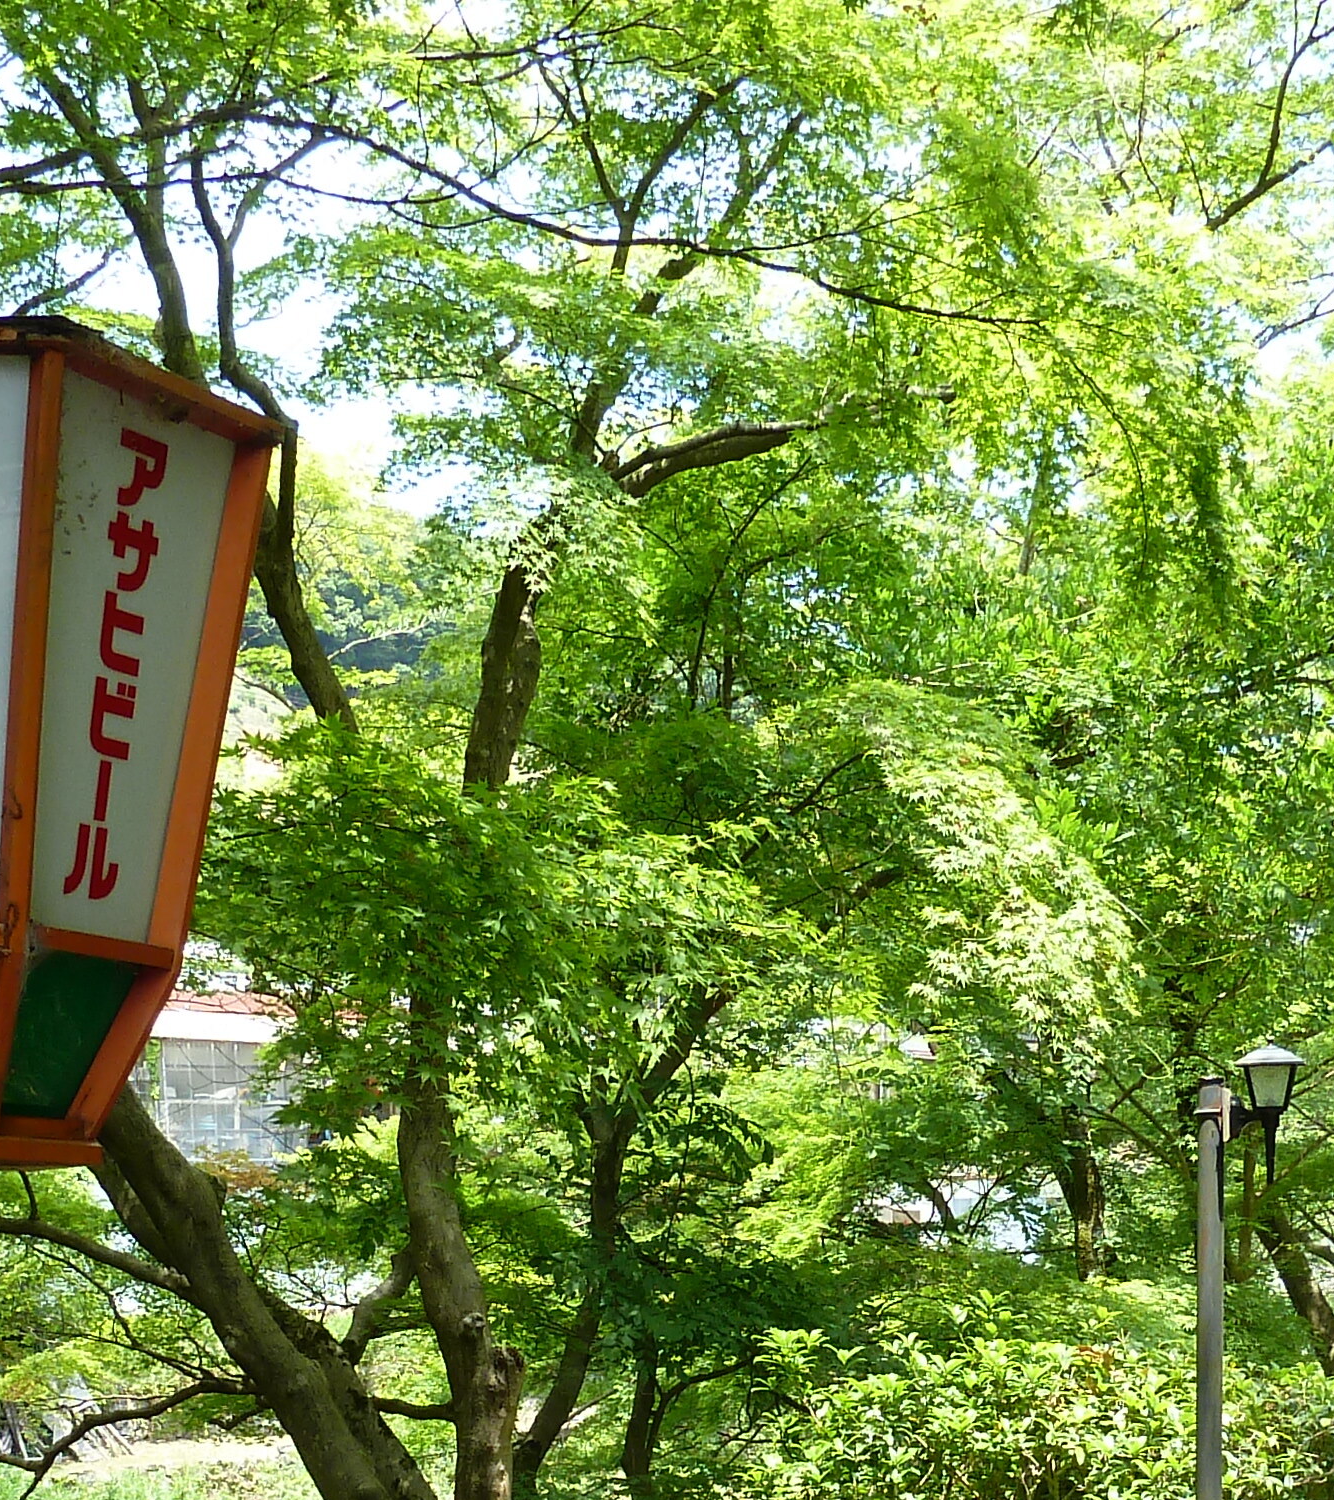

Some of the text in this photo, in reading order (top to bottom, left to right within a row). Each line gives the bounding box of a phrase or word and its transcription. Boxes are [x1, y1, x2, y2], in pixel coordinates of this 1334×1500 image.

[63, 427, 168, 900] アサヒビール
